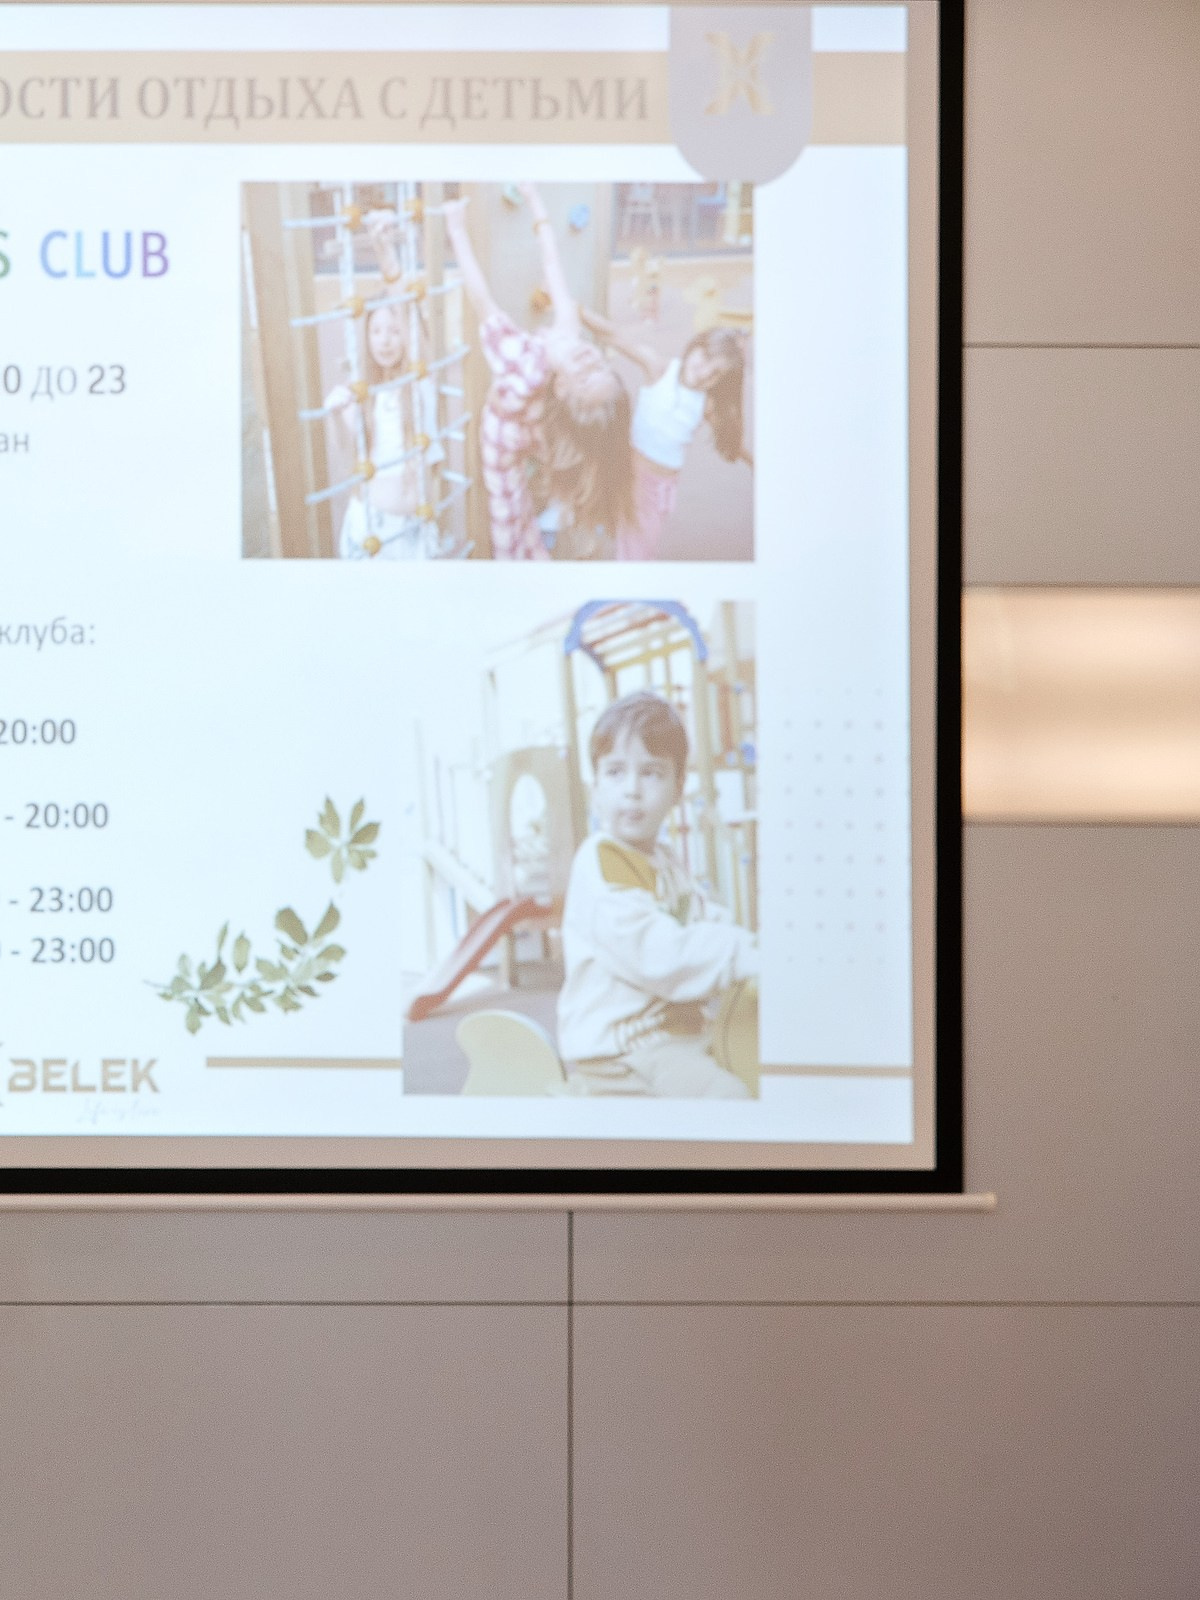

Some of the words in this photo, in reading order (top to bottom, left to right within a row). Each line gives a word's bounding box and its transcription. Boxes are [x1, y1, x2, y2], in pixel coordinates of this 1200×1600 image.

[136, 76, 364, 130] ОТДЫХА
[379, 77, 408, 120] С
[418, 77, 648, 130] ДЕТЬМИ
[39, 230, 168, 279] CLUB
[29, 365, 78, 402] ДО
[87, 363, 128, 397] 23
[24, 801, 111, 831] 20:00
[28, 885, 115, 914] 23:00
[30, 936, 117, 965] 23:00
[7, 1057, 161, 1094] BELEK
